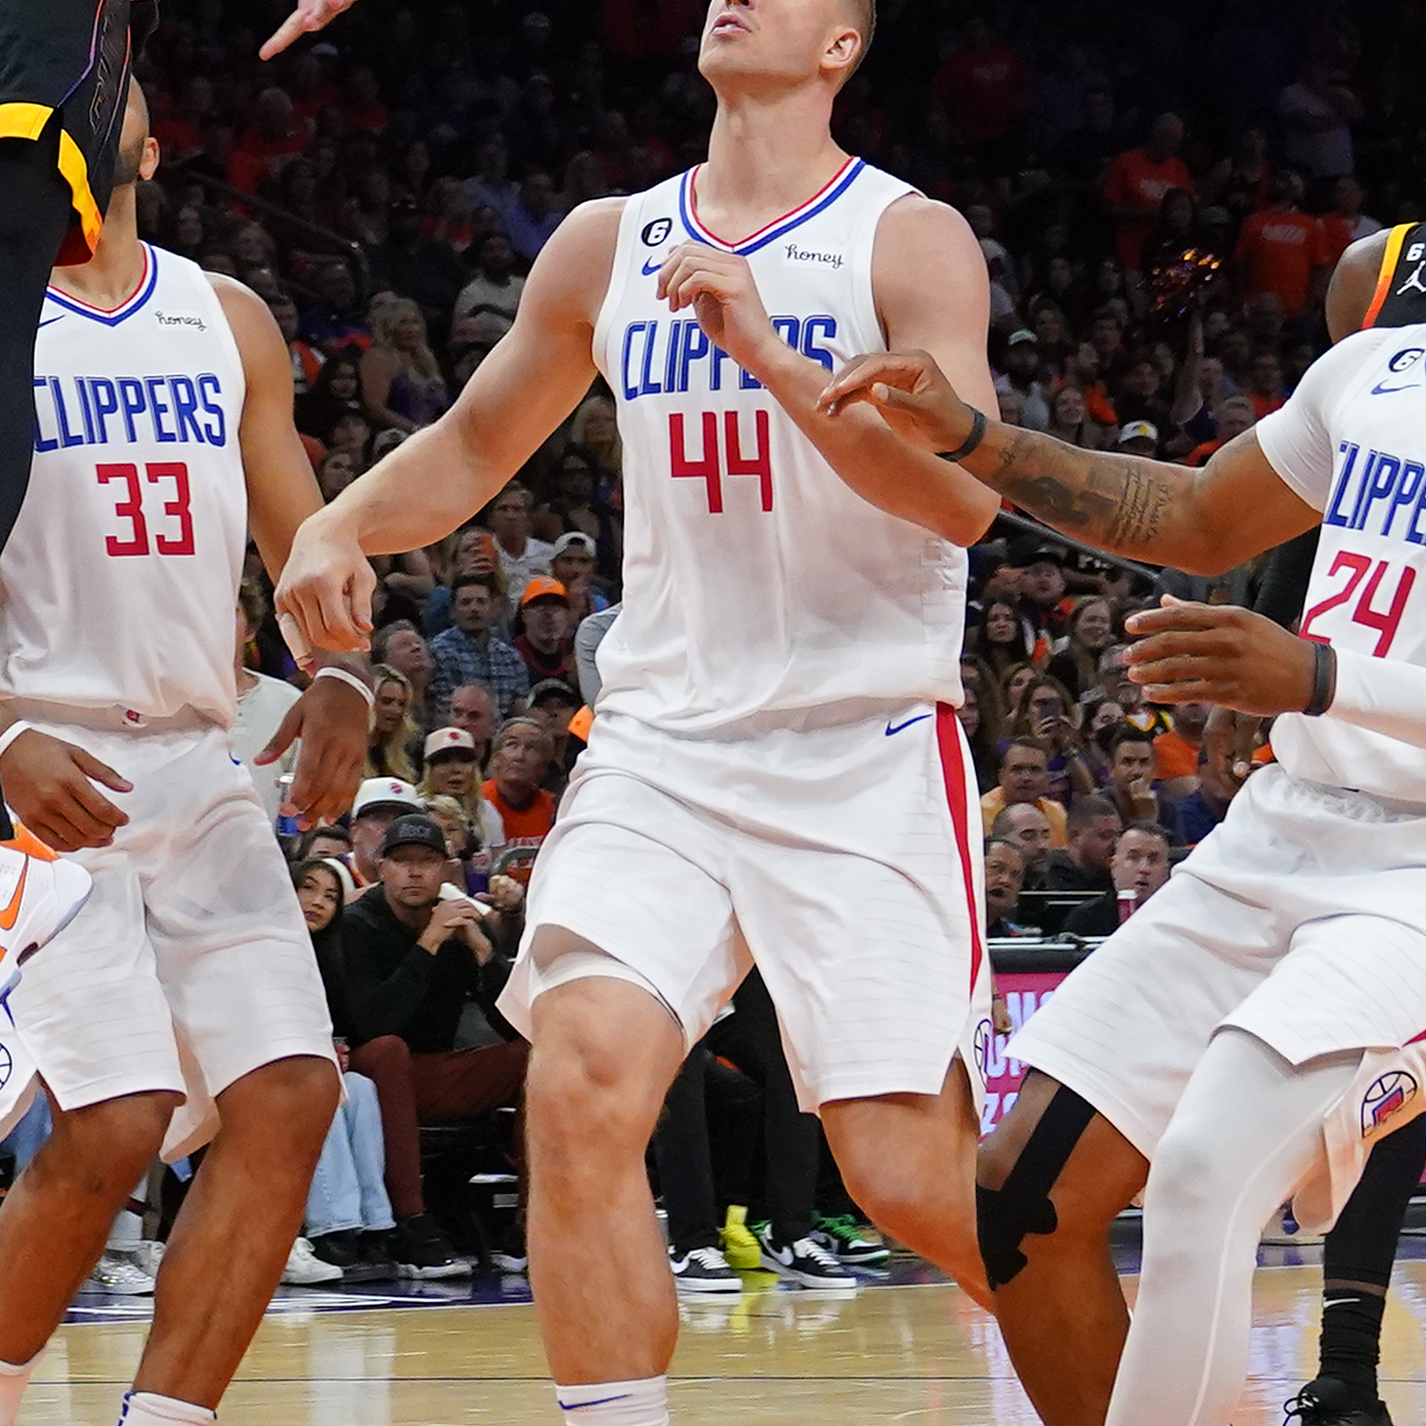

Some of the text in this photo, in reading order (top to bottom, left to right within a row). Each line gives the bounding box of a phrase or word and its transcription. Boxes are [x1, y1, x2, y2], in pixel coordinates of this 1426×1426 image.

[785, 243, 845, 268] honey
[1405, 242, 1425, 262] 6
[621, 314, 837, 401] CLIPS
[669, 410, 774, 513] 44
[95, 461, 196, 557] 33
[1299, 550, 1417, 658] 24
